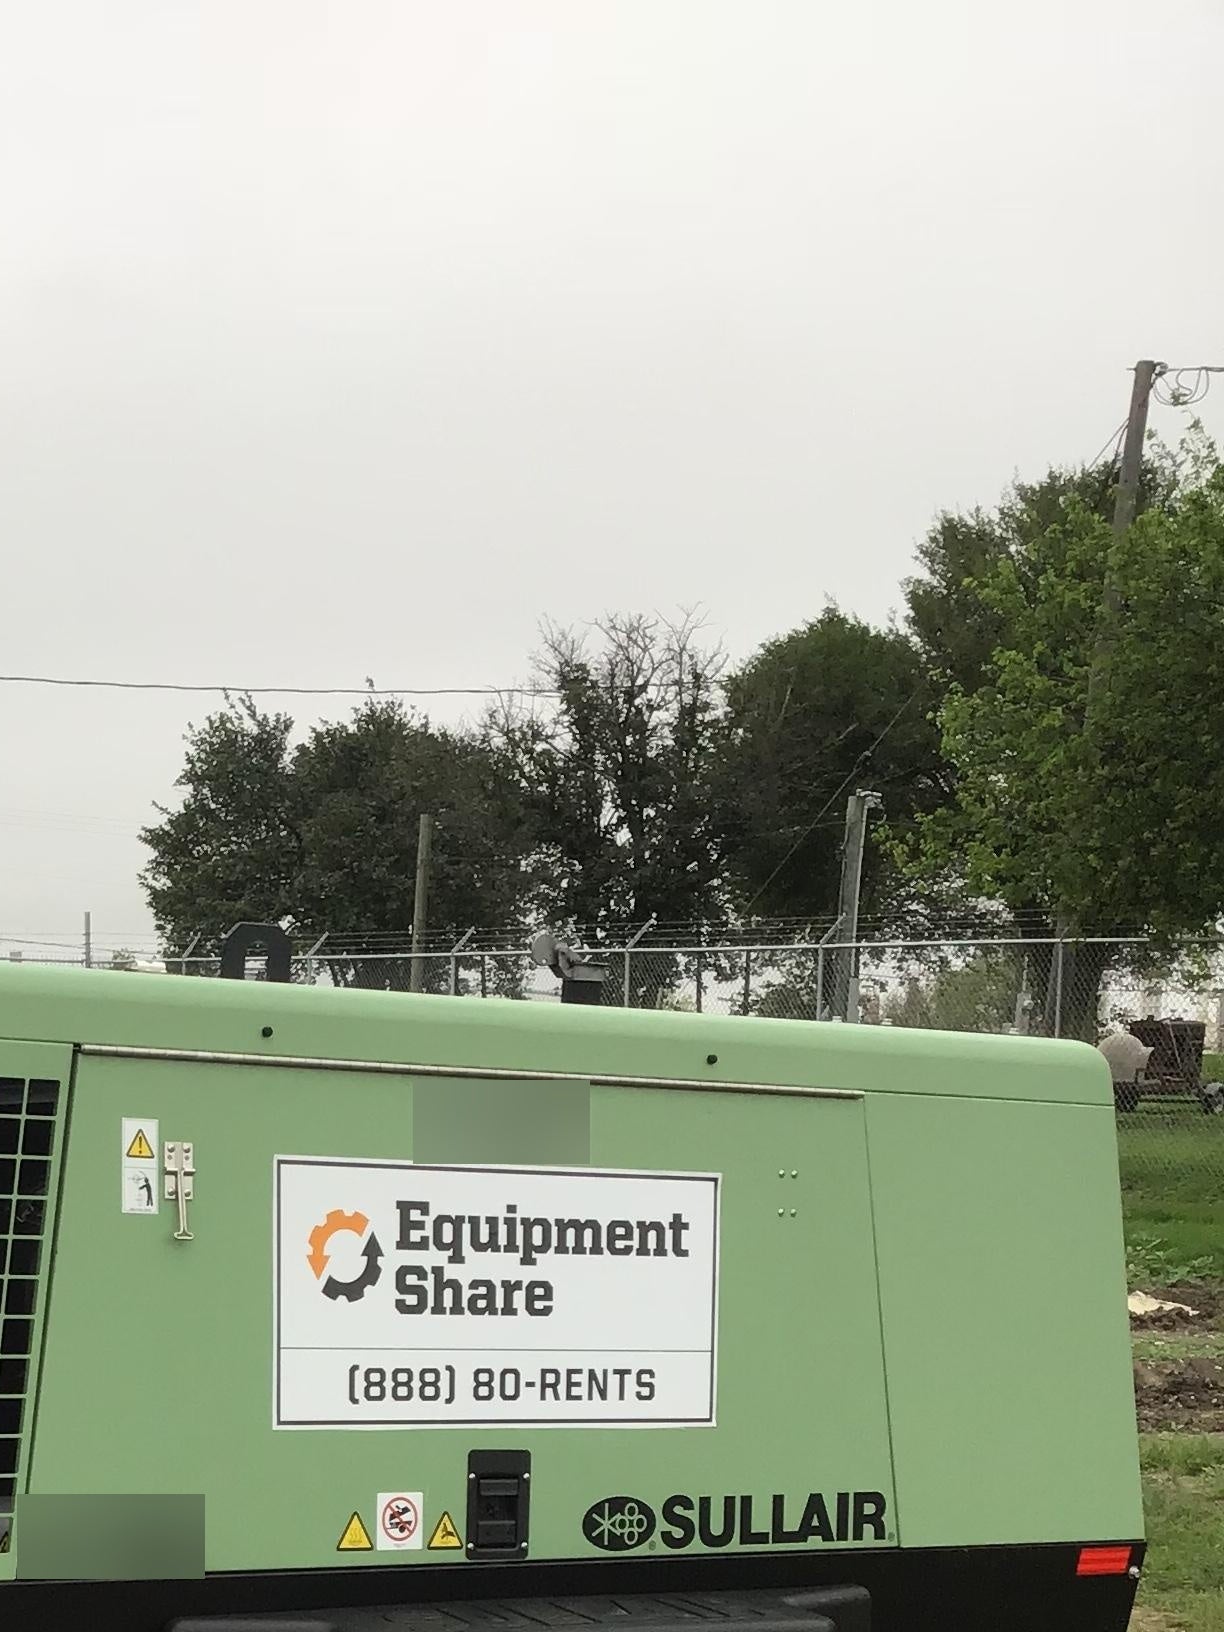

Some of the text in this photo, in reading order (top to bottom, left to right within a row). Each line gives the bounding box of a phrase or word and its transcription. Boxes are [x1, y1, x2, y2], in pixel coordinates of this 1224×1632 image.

[395, 1199, 690, 1266] Equipment
[395, 1264, 554, 1317] Share
[348, 1364, 656, 1405] (888) 80-RENTS
[660, 1491, 887, 1549] SULLAIR
